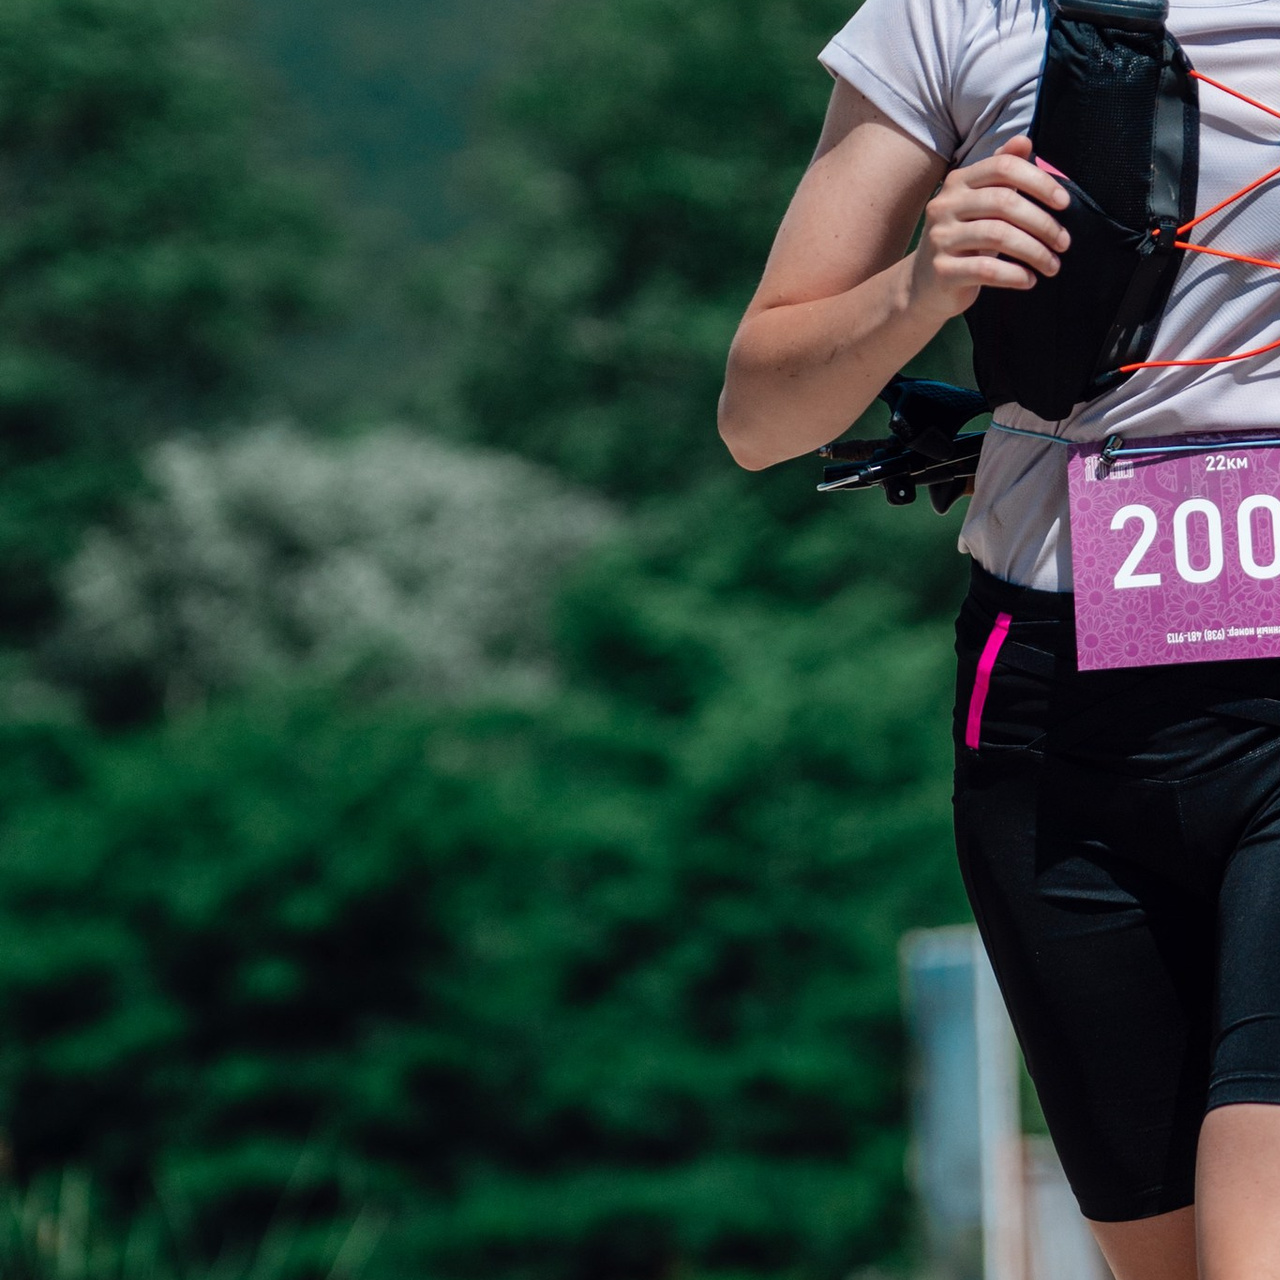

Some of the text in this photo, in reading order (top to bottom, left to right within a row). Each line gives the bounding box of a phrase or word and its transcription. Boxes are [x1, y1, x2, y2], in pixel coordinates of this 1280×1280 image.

[1166, 631, 1202, 644] 481-9113
[1204, 628, 1225, 642] (938)
[1227, 626, 1255, 637] номер:
